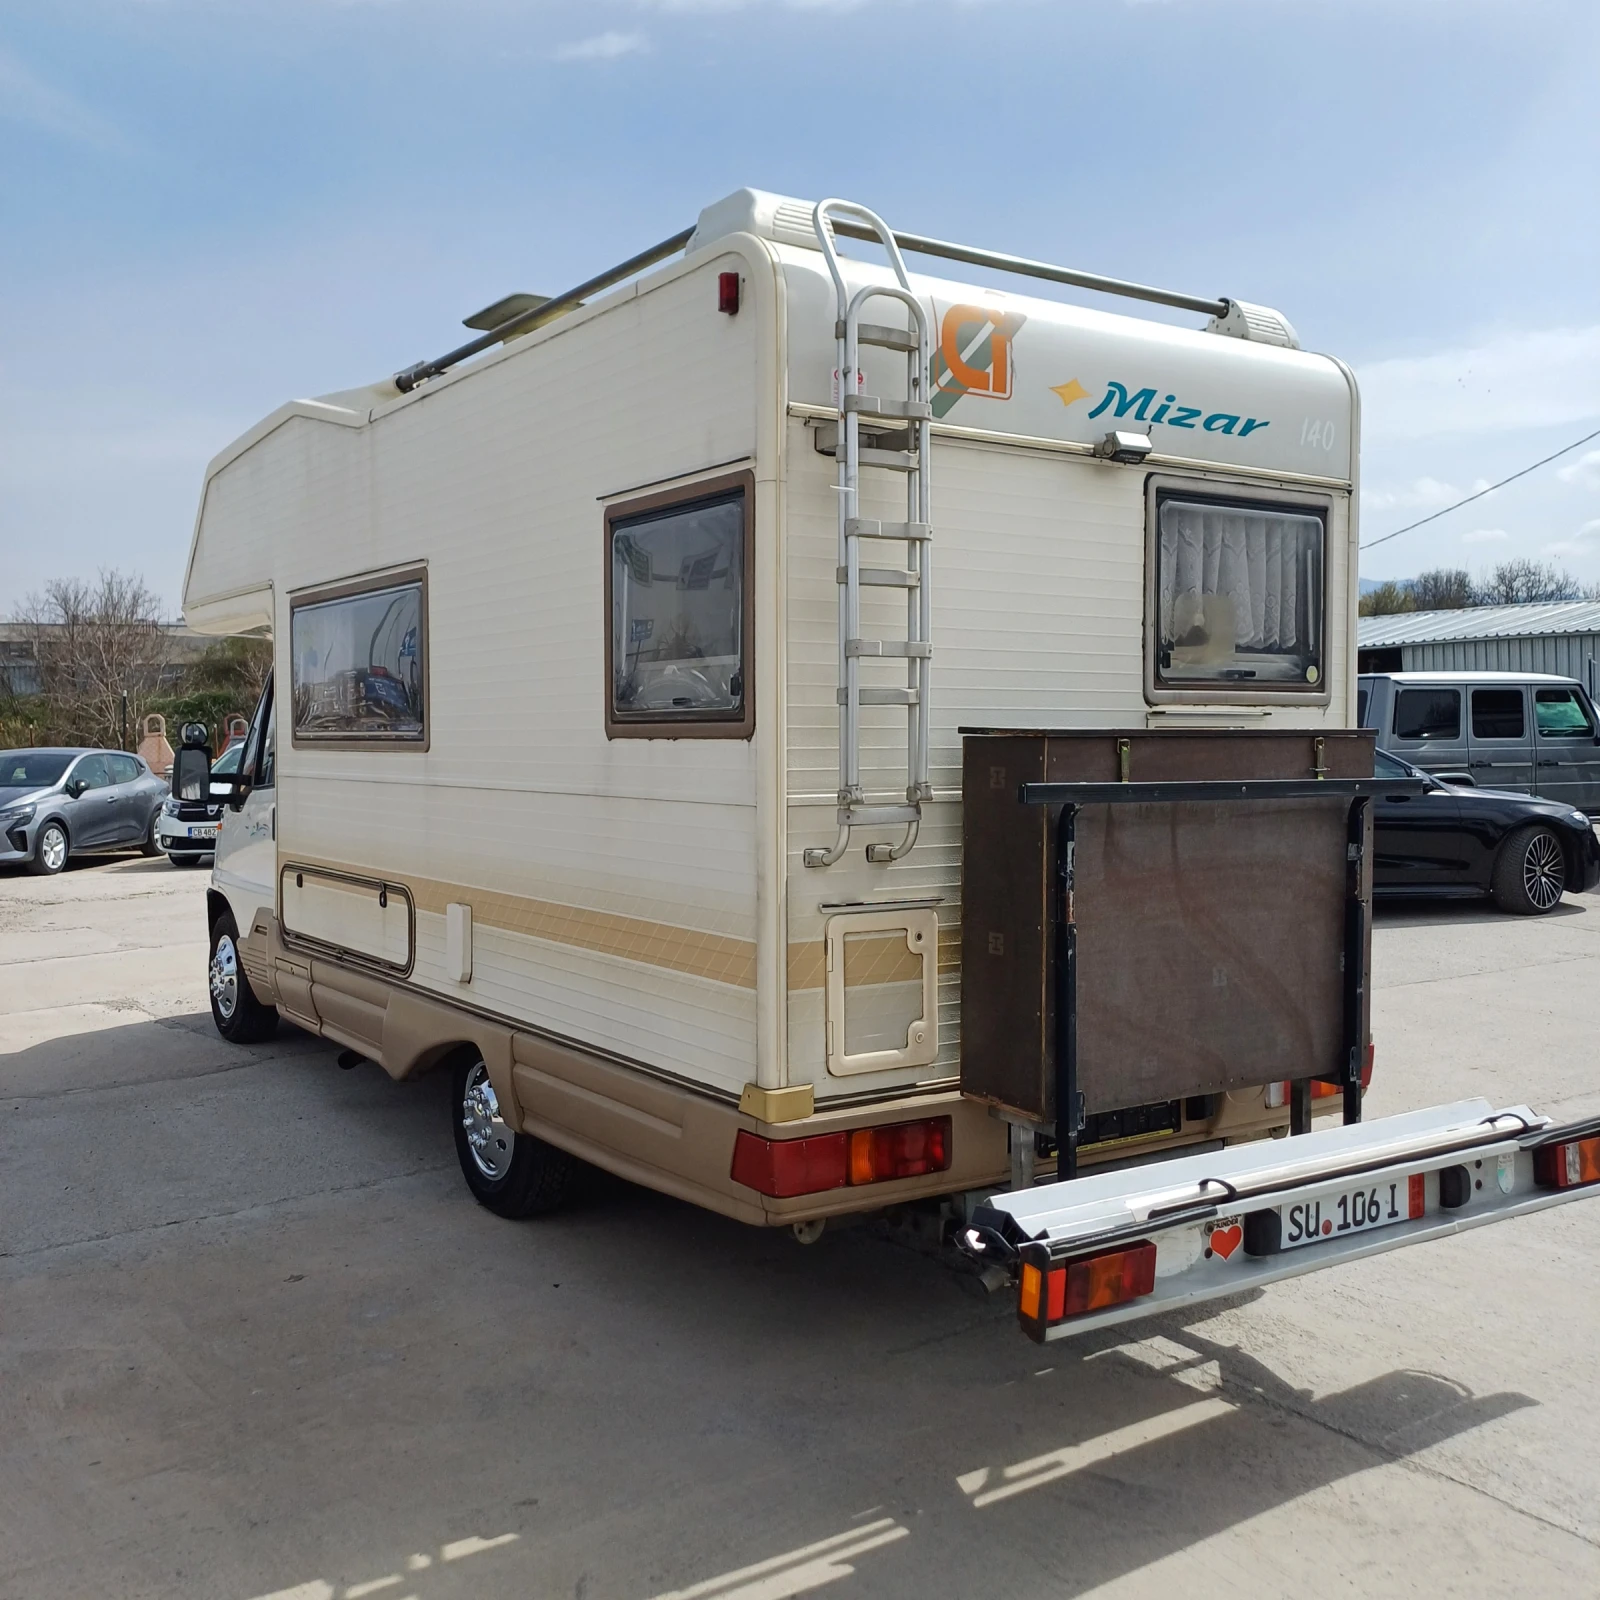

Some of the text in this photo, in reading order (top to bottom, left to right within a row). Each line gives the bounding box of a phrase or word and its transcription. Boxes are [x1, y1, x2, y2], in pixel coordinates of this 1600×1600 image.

[1088, 381, 1270, 437] Mizar
[1300, 416, 1335, 451] 140
[1288, 1201, 1320, 1242] SU
[1337, 1188, 1380, 1231] 106
